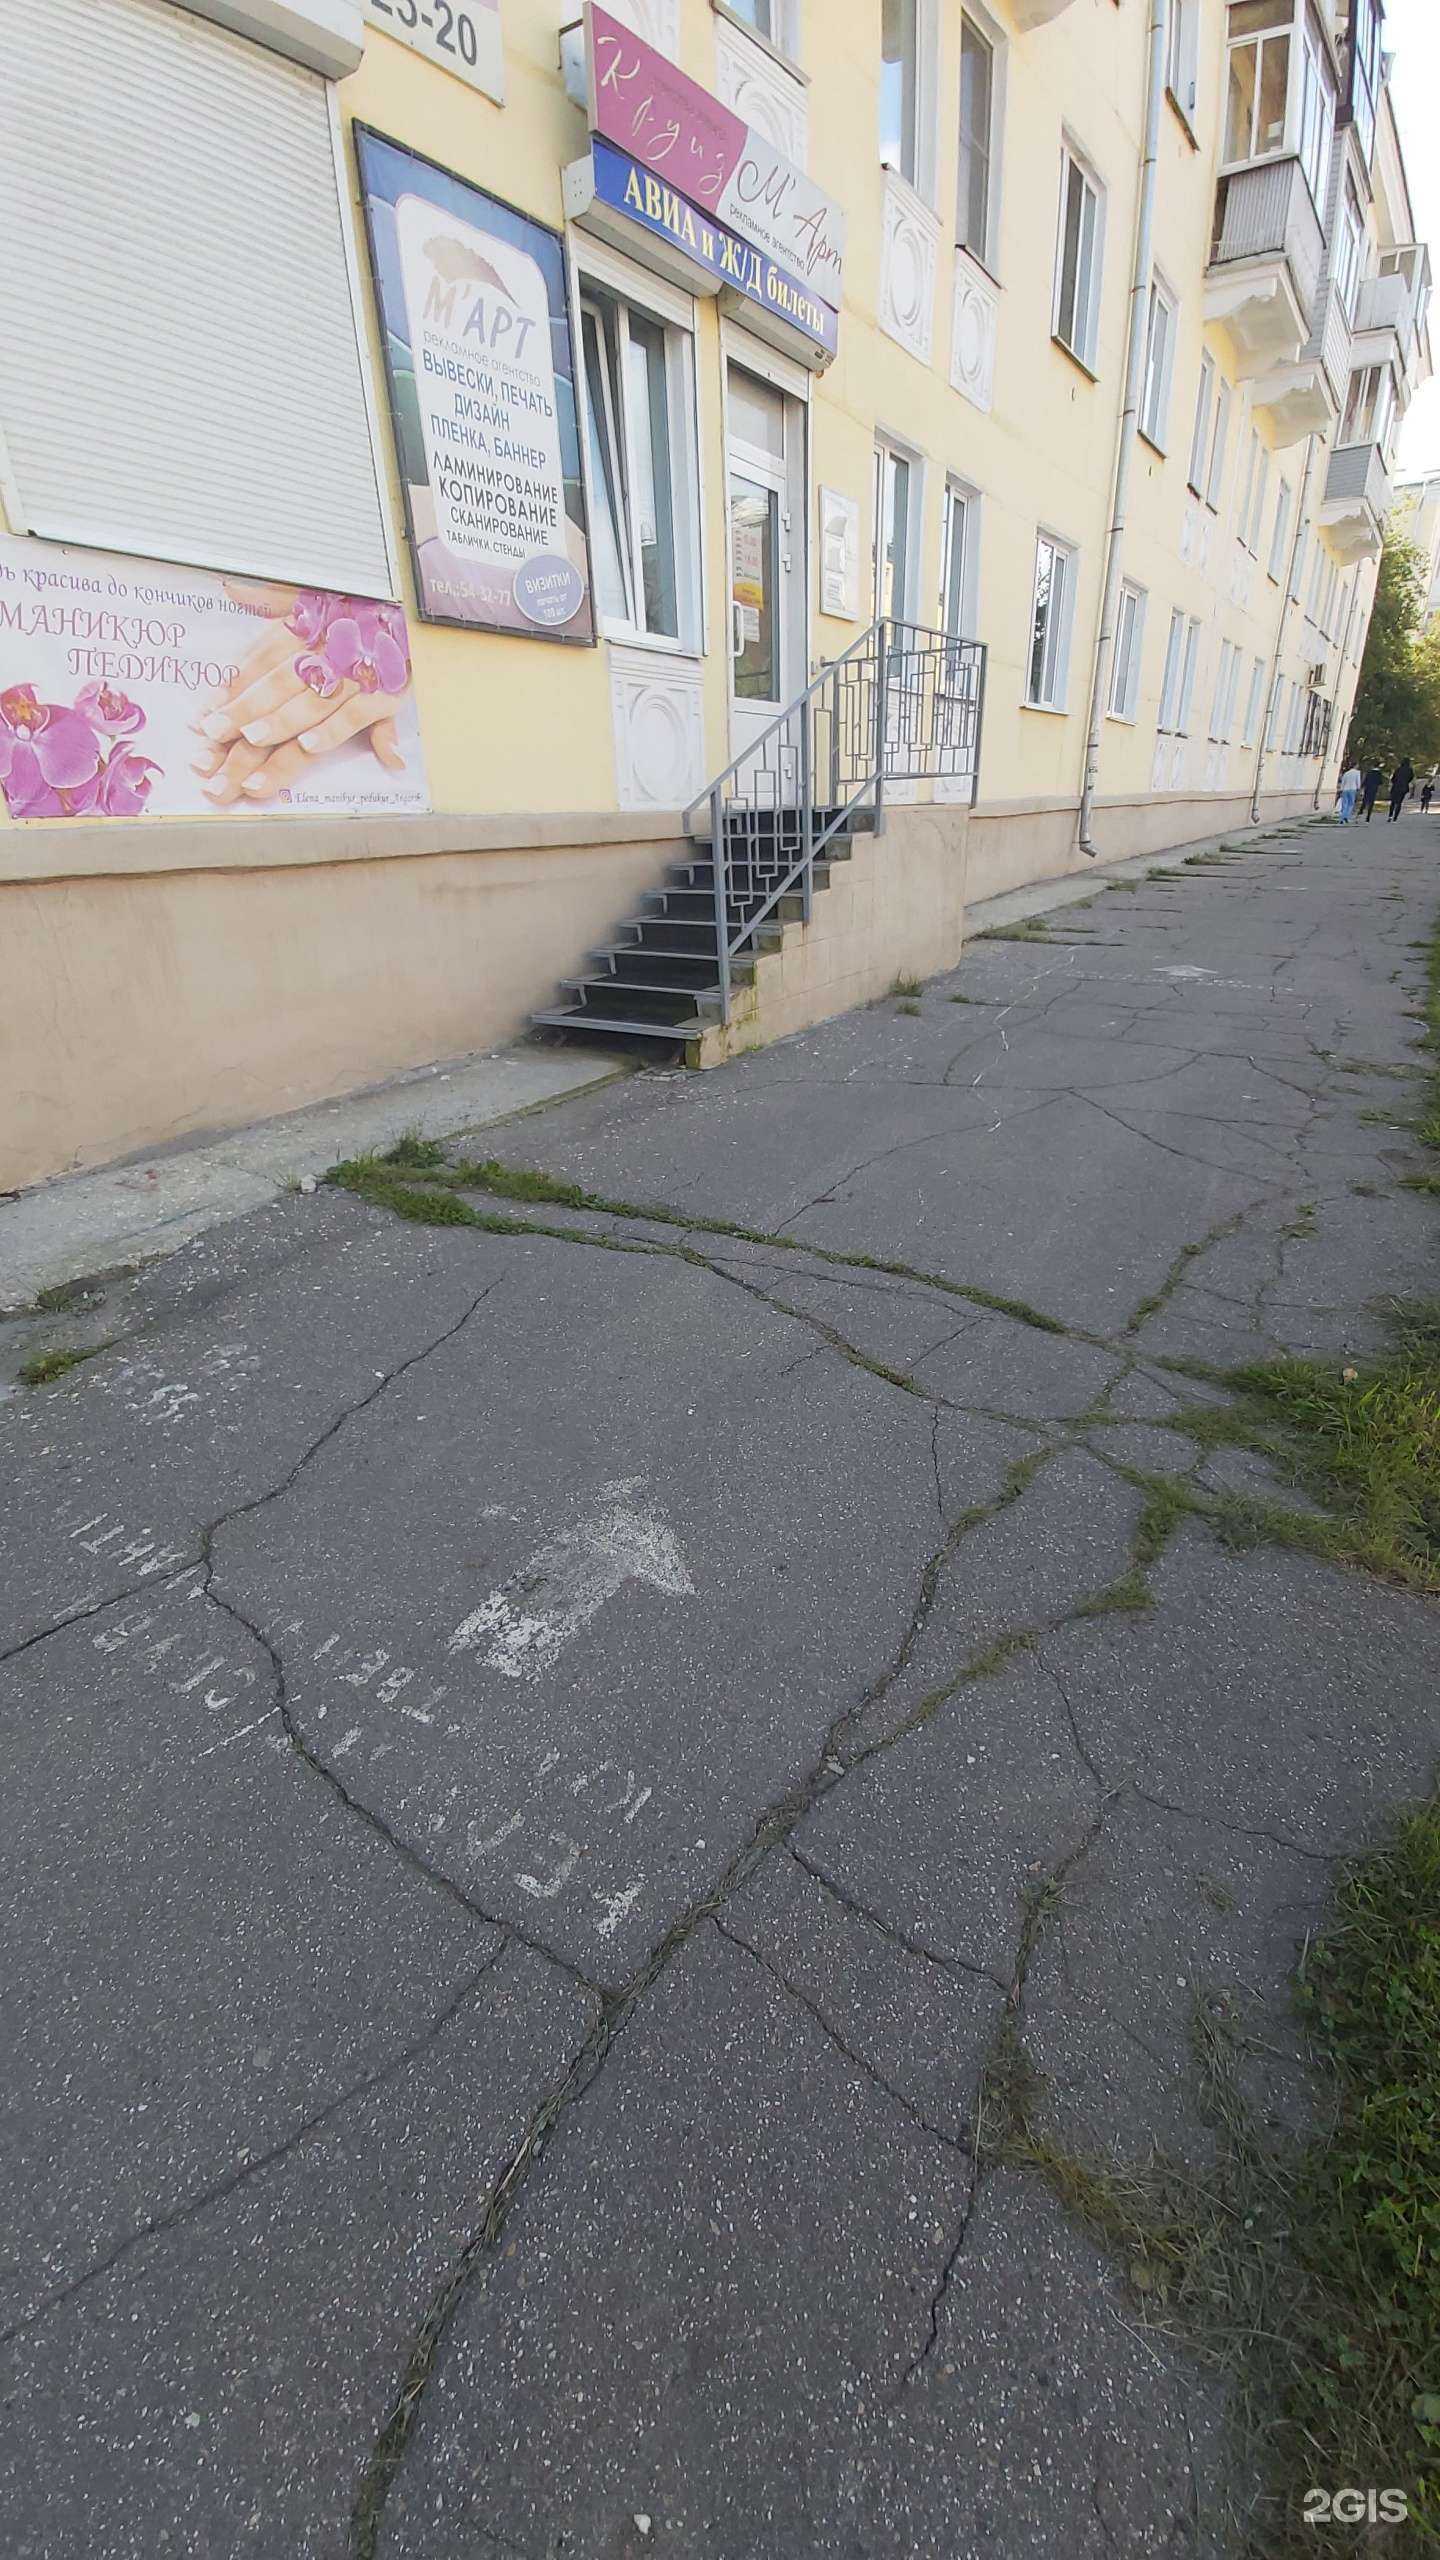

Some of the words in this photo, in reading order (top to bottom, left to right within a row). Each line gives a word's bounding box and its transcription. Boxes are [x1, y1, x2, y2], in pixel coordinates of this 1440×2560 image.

[729, 203, 771, 244] рекламное
[624, 167, 697, 247] АВИА
[702, 229, 715, 262] и
[718, 231, 763, 299] Ж/Д
[766, 265, 825, 335] билеты
[423, 348, 498, 402] ВЫВЕСКИ,
[500, 382, 553, 418] ПЕЧАТЬ
[454, 393, 510, 431] ДИЗАЙН
[431, 414, 491, 458] ПЛЕНКА,
[493, 437, 546, 470] БАННЕР
[433, 450, 558, 504] ЛАМИНИРОВАНИЕ
[438, 476, 557, 528] КОПИРОВАНИЕ
[450, 506, 549, 546] СКАНИРОВАНИЕ
[493, 542, 526, 559] СТЕНДЫ
[23, 567, 102, 593] красива
[108, 574, 128, 597] до
[134, 585, 214, 614] кончиков
[219, 599, 274, 620] ногтей
[525, 571, 572, 594] ВИЗИТКИ
[0, 600, 186, 649] МАНИКЮР
[67, 647, 241, 691] ПЕДИКЮР
